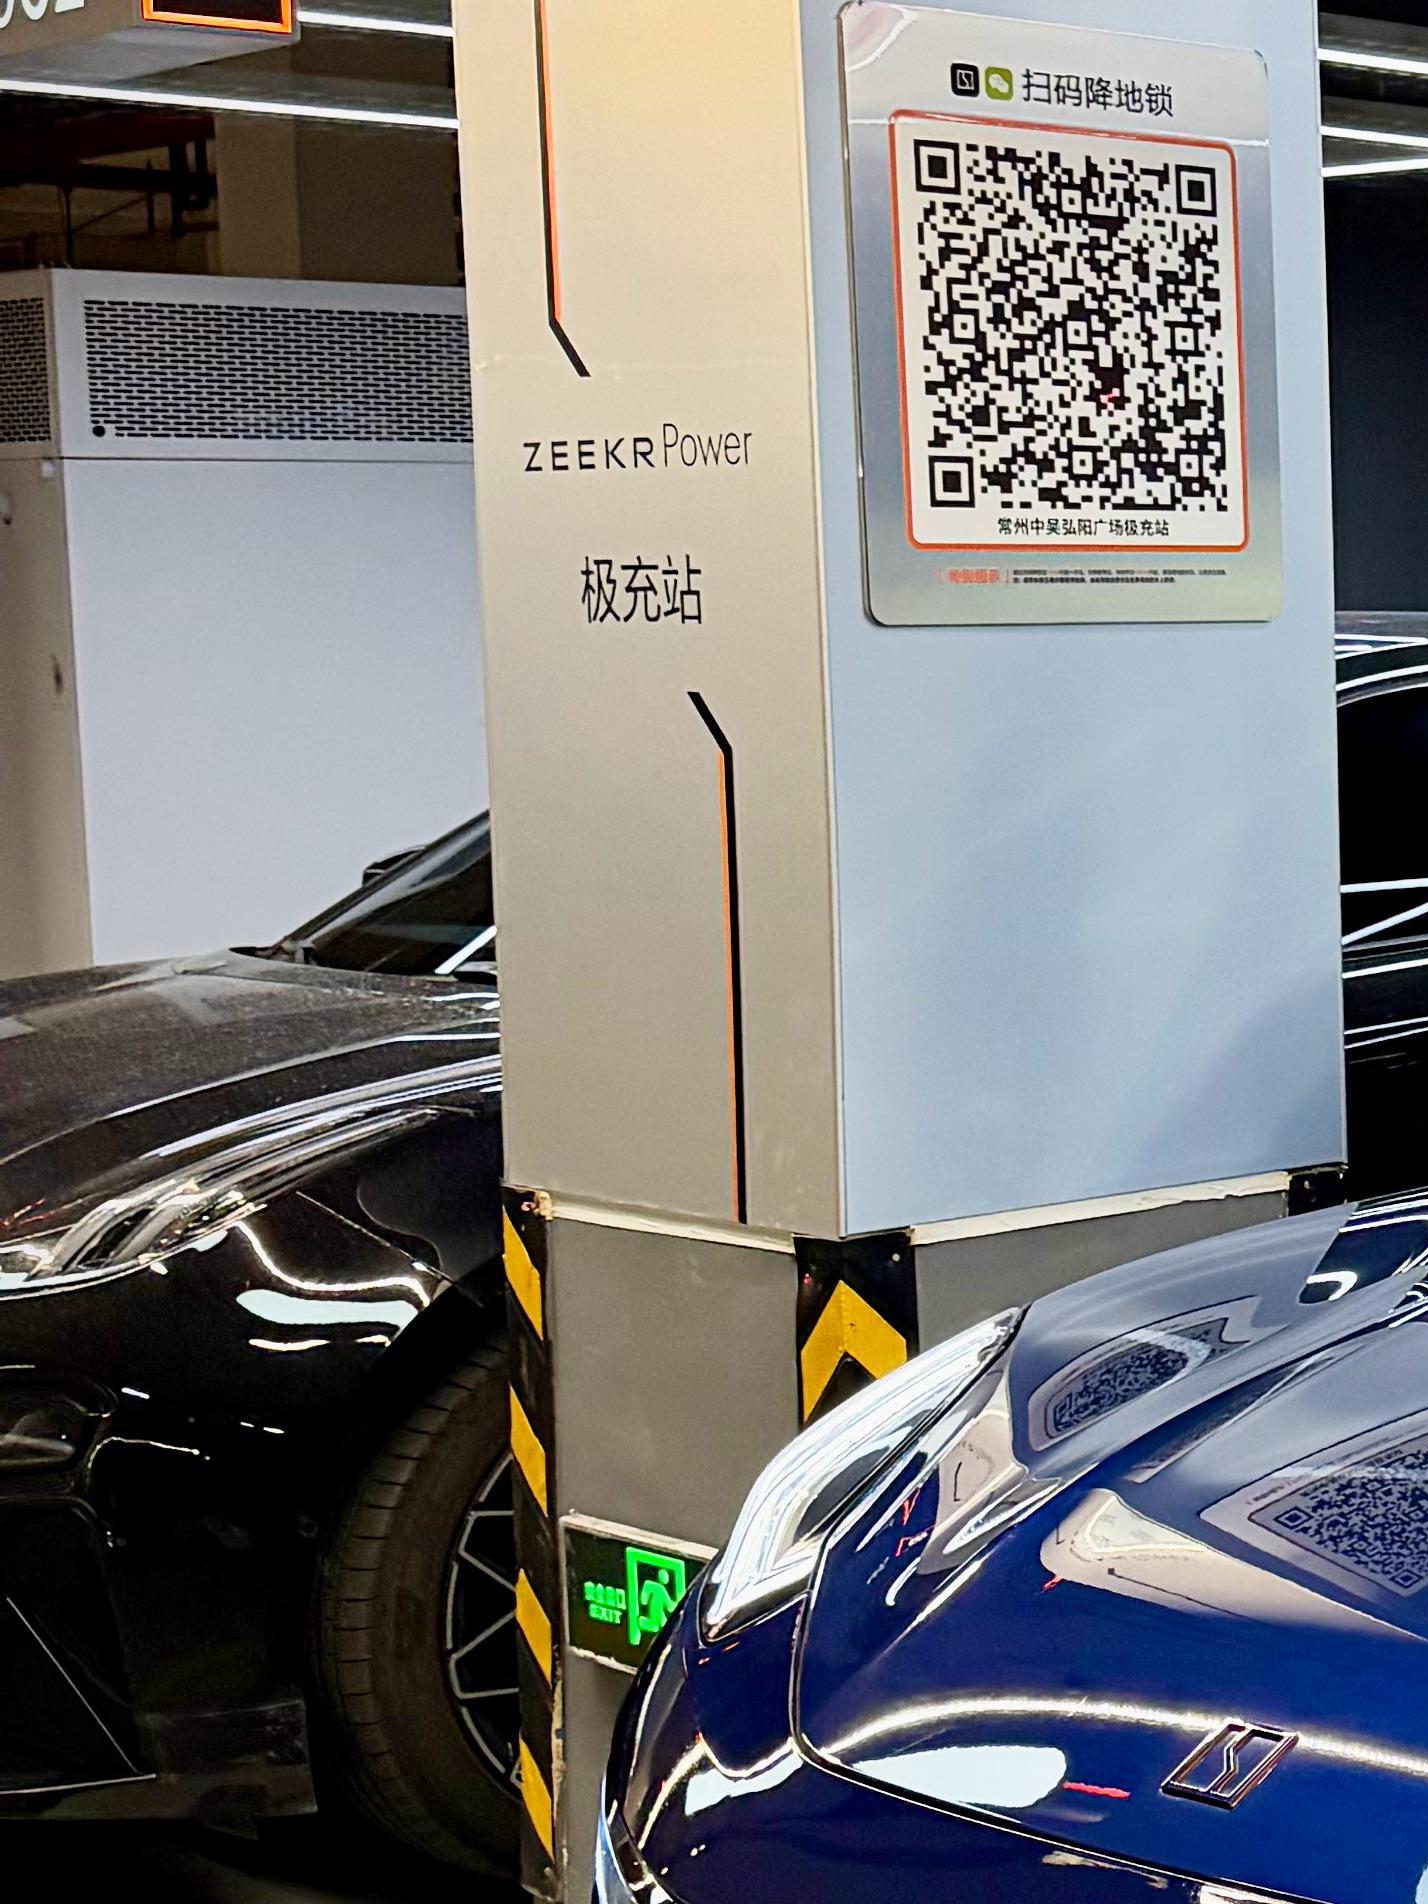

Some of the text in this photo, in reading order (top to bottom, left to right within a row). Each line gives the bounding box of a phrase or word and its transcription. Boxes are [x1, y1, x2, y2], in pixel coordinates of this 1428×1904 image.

[1020, 68, 1174, 117] 扫码降地锁
[997, 517, 1170, 537] 常州中吴弘阳广场极充站
[580, 553, 702, 625] 极充站
[589, 1603, 622, 1624] EXIT
